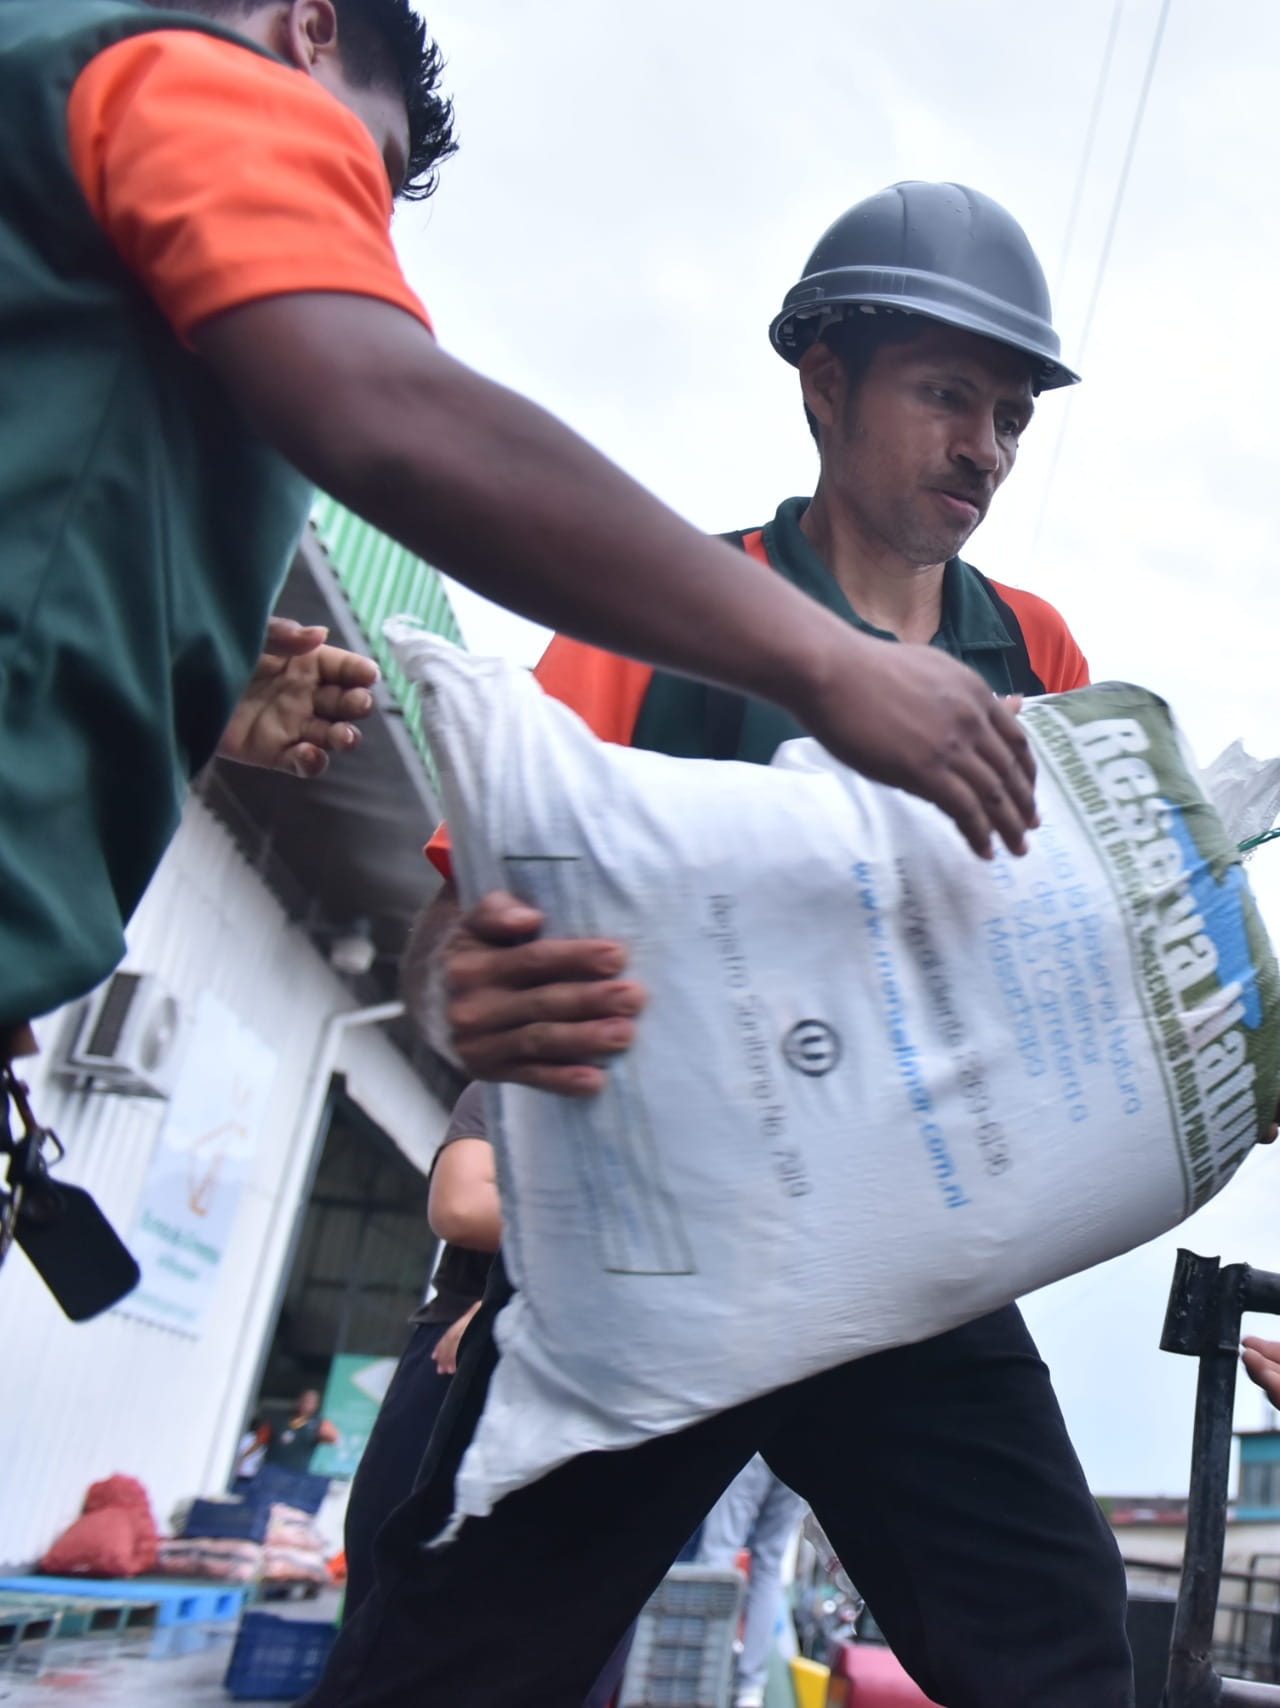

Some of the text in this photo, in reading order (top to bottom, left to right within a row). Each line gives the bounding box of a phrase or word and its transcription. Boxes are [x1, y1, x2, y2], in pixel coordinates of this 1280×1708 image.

[1093, 816, 1123, 839] EL
[701, 894, 748, 988] Registro
[733, 995, 776, 1099] Sanitario
[983, 918, 1048, 1077] Masachapa
[1033, 881, 1102, 1065] de Montelimar
[1078, 914, 1120, 1023] Reserva
[1034, 971, 1084, 1099] Carretera
[1171, 1062, 1204, 1117] AGUA
[1183, 1118, 1212, 1159] PARA
